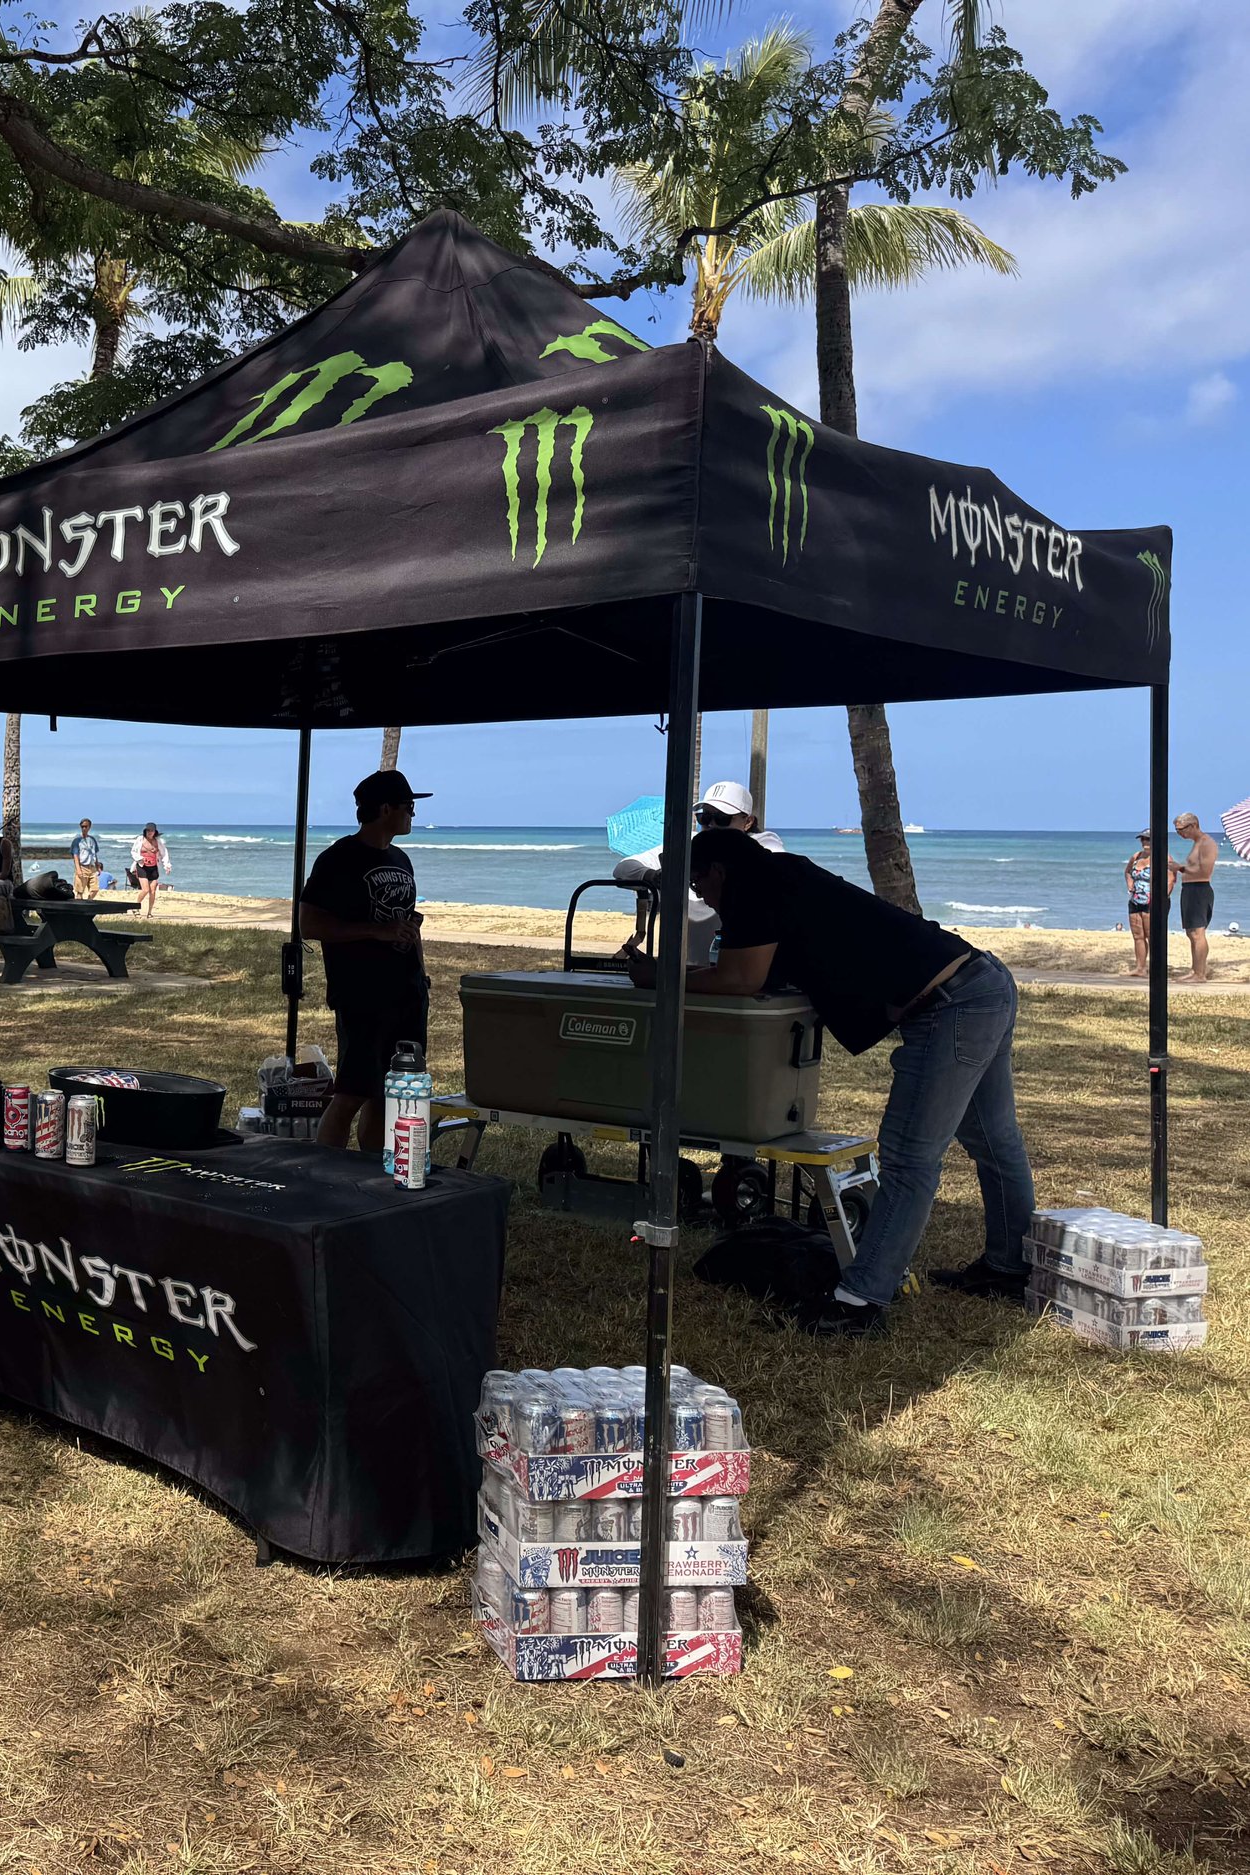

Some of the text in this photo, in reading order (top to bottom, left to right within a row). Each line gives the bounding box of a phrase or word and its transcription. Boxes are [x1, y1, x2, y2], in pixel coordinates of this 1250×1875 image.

[928, 484, 1084, 592] MONSTER
[953, 579, 1063, 628] ENERGY
[370, 871, 413, 887] MONSTER
[568, 1017, 617, 1035] Coleman
[291, 1100, 323, 1108] REIGN
[9, 1288, 210, 1374] ENERGY
[579, 1549, 641, 1565] JUICE
[581, 1566, 640, 1577] MONSTER
